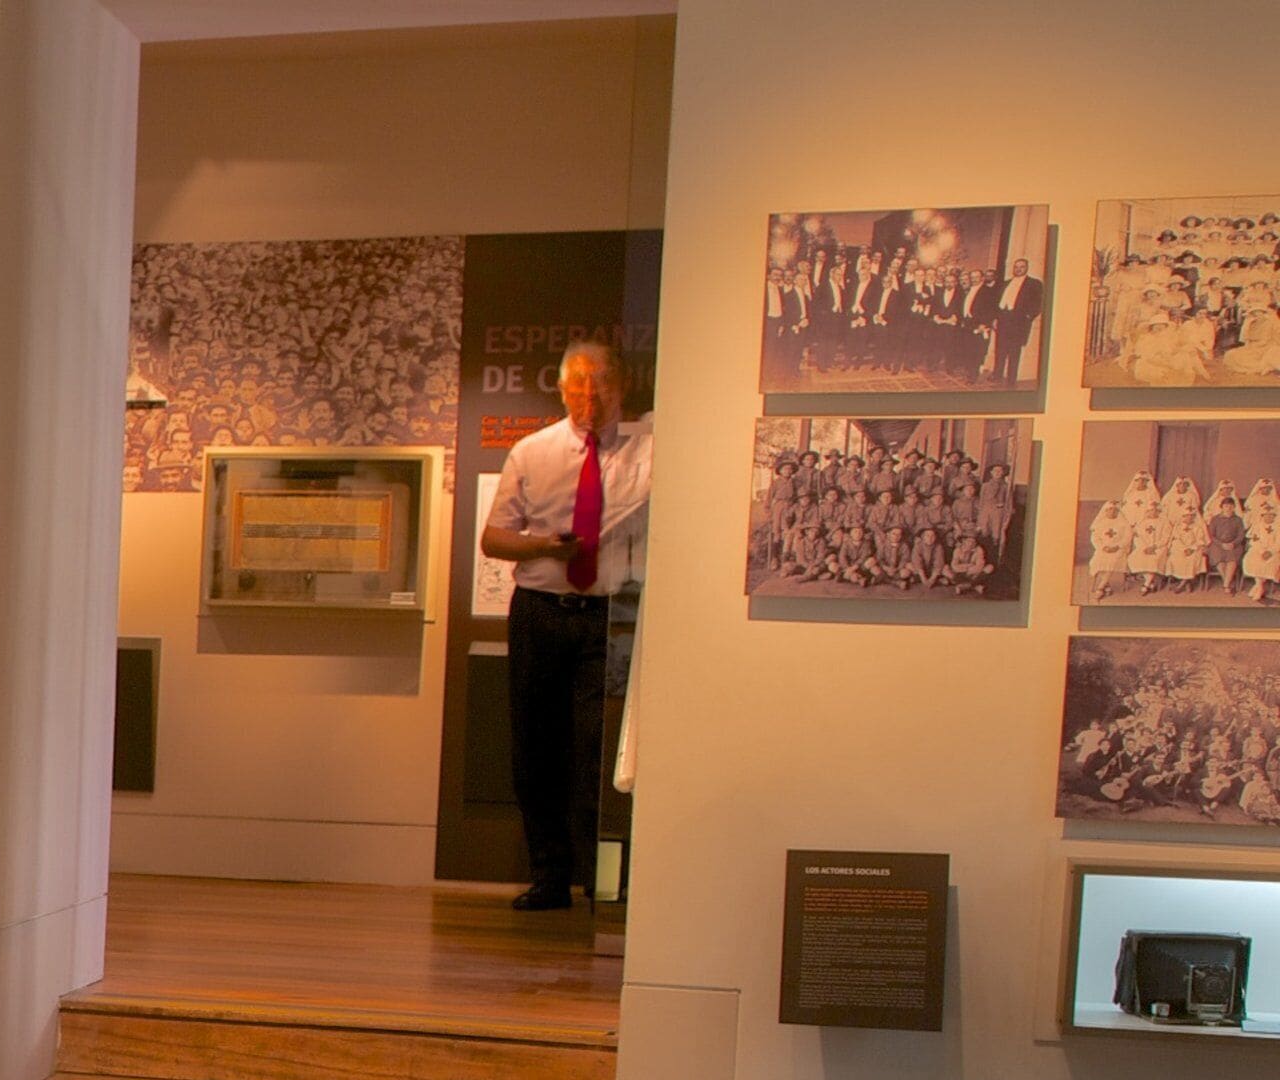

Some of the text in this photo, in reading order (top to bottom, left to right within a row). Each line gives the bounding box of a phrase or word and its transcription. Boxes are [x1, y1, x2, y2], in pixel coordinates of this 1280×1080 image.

[484, 324, 655, 353] ESPERANZ
[482, 365, 524, 392] DE
[804, 866, 890, 876] LOS ACTORES SOCIALES
